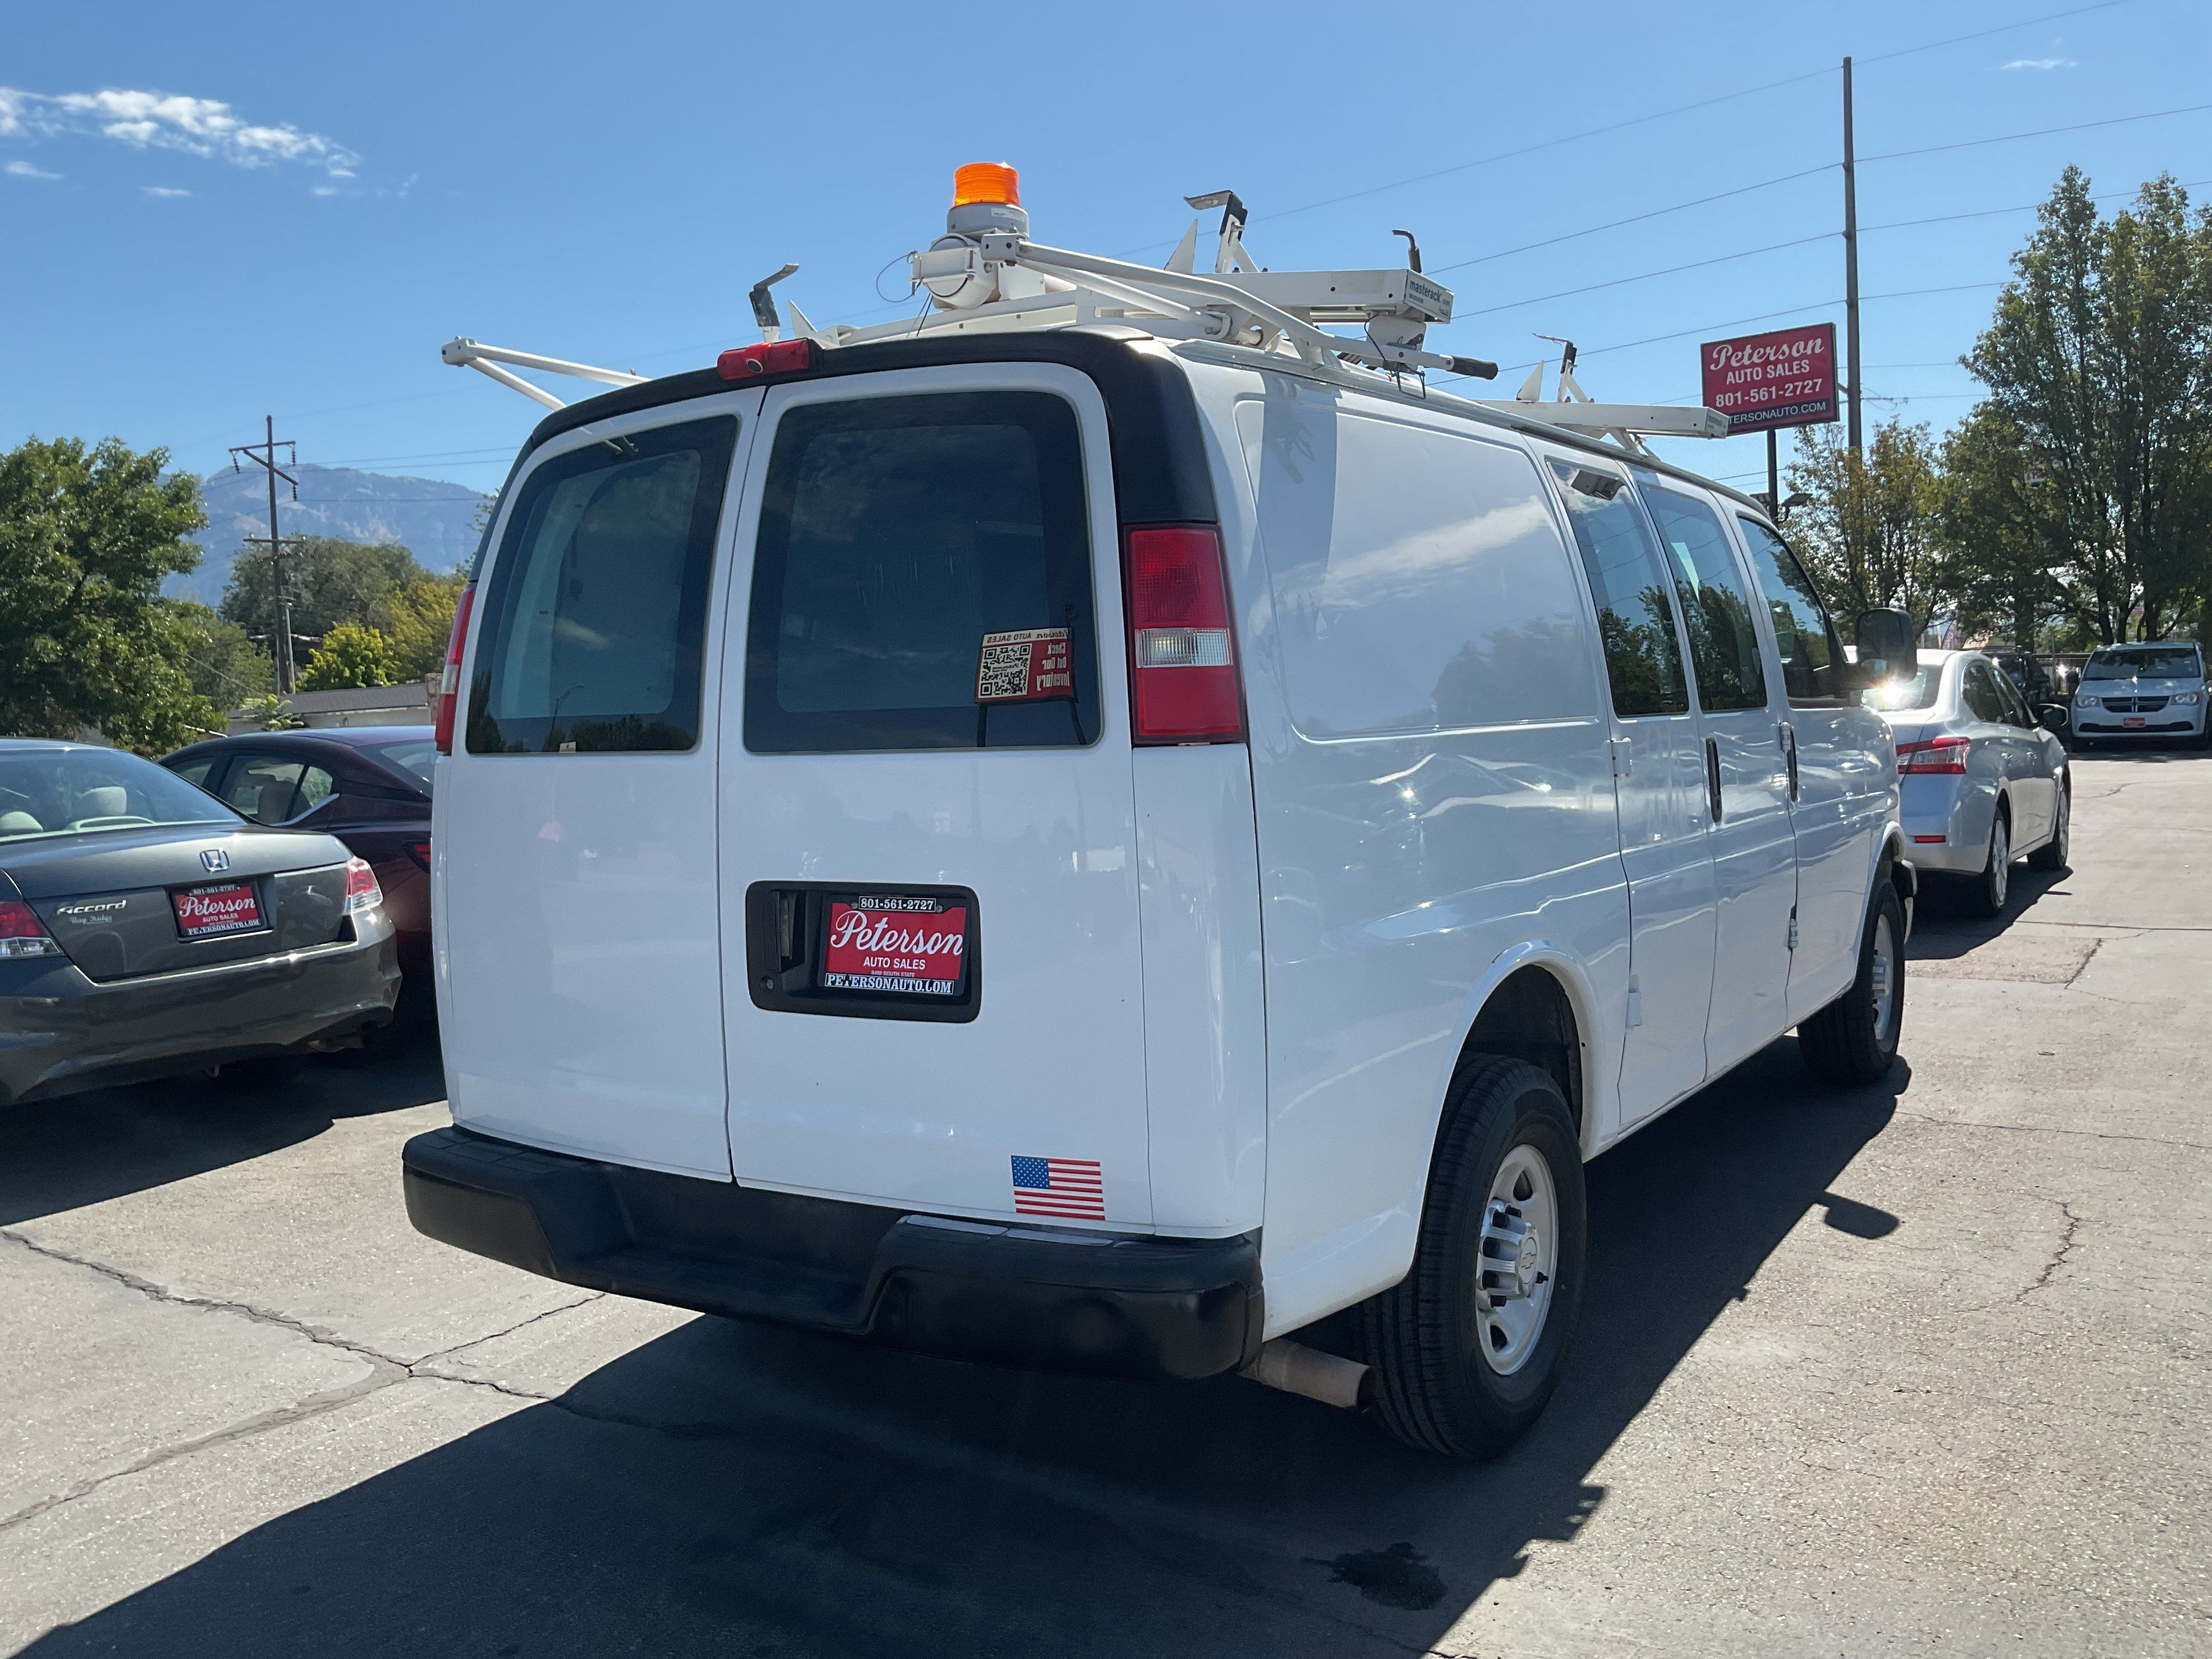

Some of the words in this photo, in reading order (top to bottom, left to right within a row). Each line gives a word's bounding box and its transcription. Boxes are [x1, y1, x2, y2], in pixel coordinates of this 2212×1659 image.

[1410, 280, 1441, 303] masterack
[1710, 337, 1824, 370] Peterson
[1726, 367, 1762, 385] AUTO
[1767, 359, 1810, 379] SALES
[1716, 378, 1822, 408] 801-561-2727
[1729, 402, 1826, 425] TERSONAUTO.COM
[57, 900, 127, 915] Accord
[179, 896, 256, 917] Peterson
[860, 898, 934, 911] 801-561-2727
[830, 910, 964, 956] Peterson
[863, 956, 890, 968] AUTO
[894, 957, 926, 970] SALES
